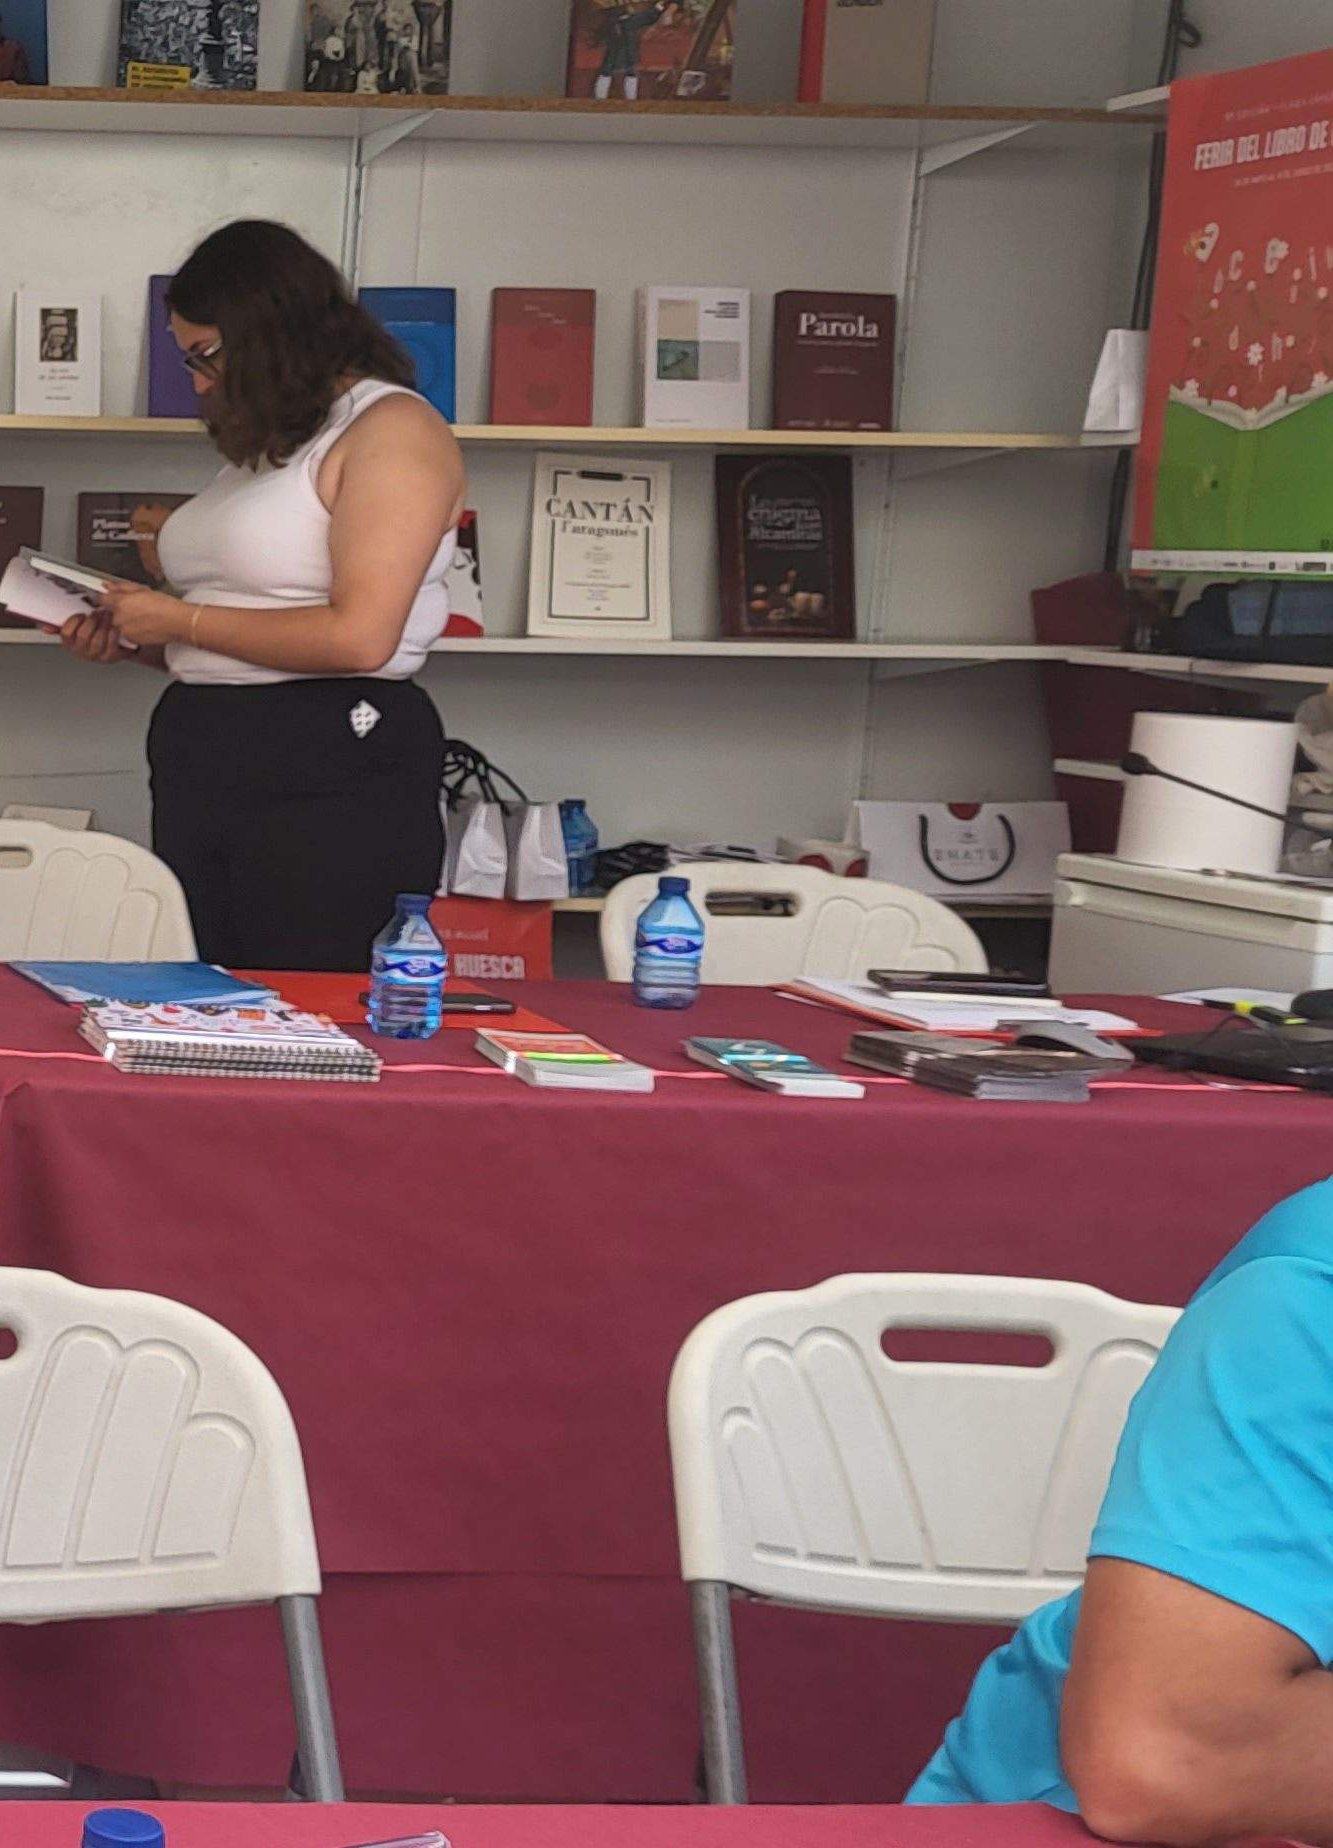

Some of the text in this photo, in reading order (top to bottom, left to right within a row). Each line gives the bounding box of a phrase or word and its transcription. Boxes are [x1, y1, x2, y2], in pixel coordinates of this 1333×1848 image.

[798, 312, 880, 339] Parola
[546, 498, 655, 524] CANTÁN
[453, 953, 526, 980] HUESCA
